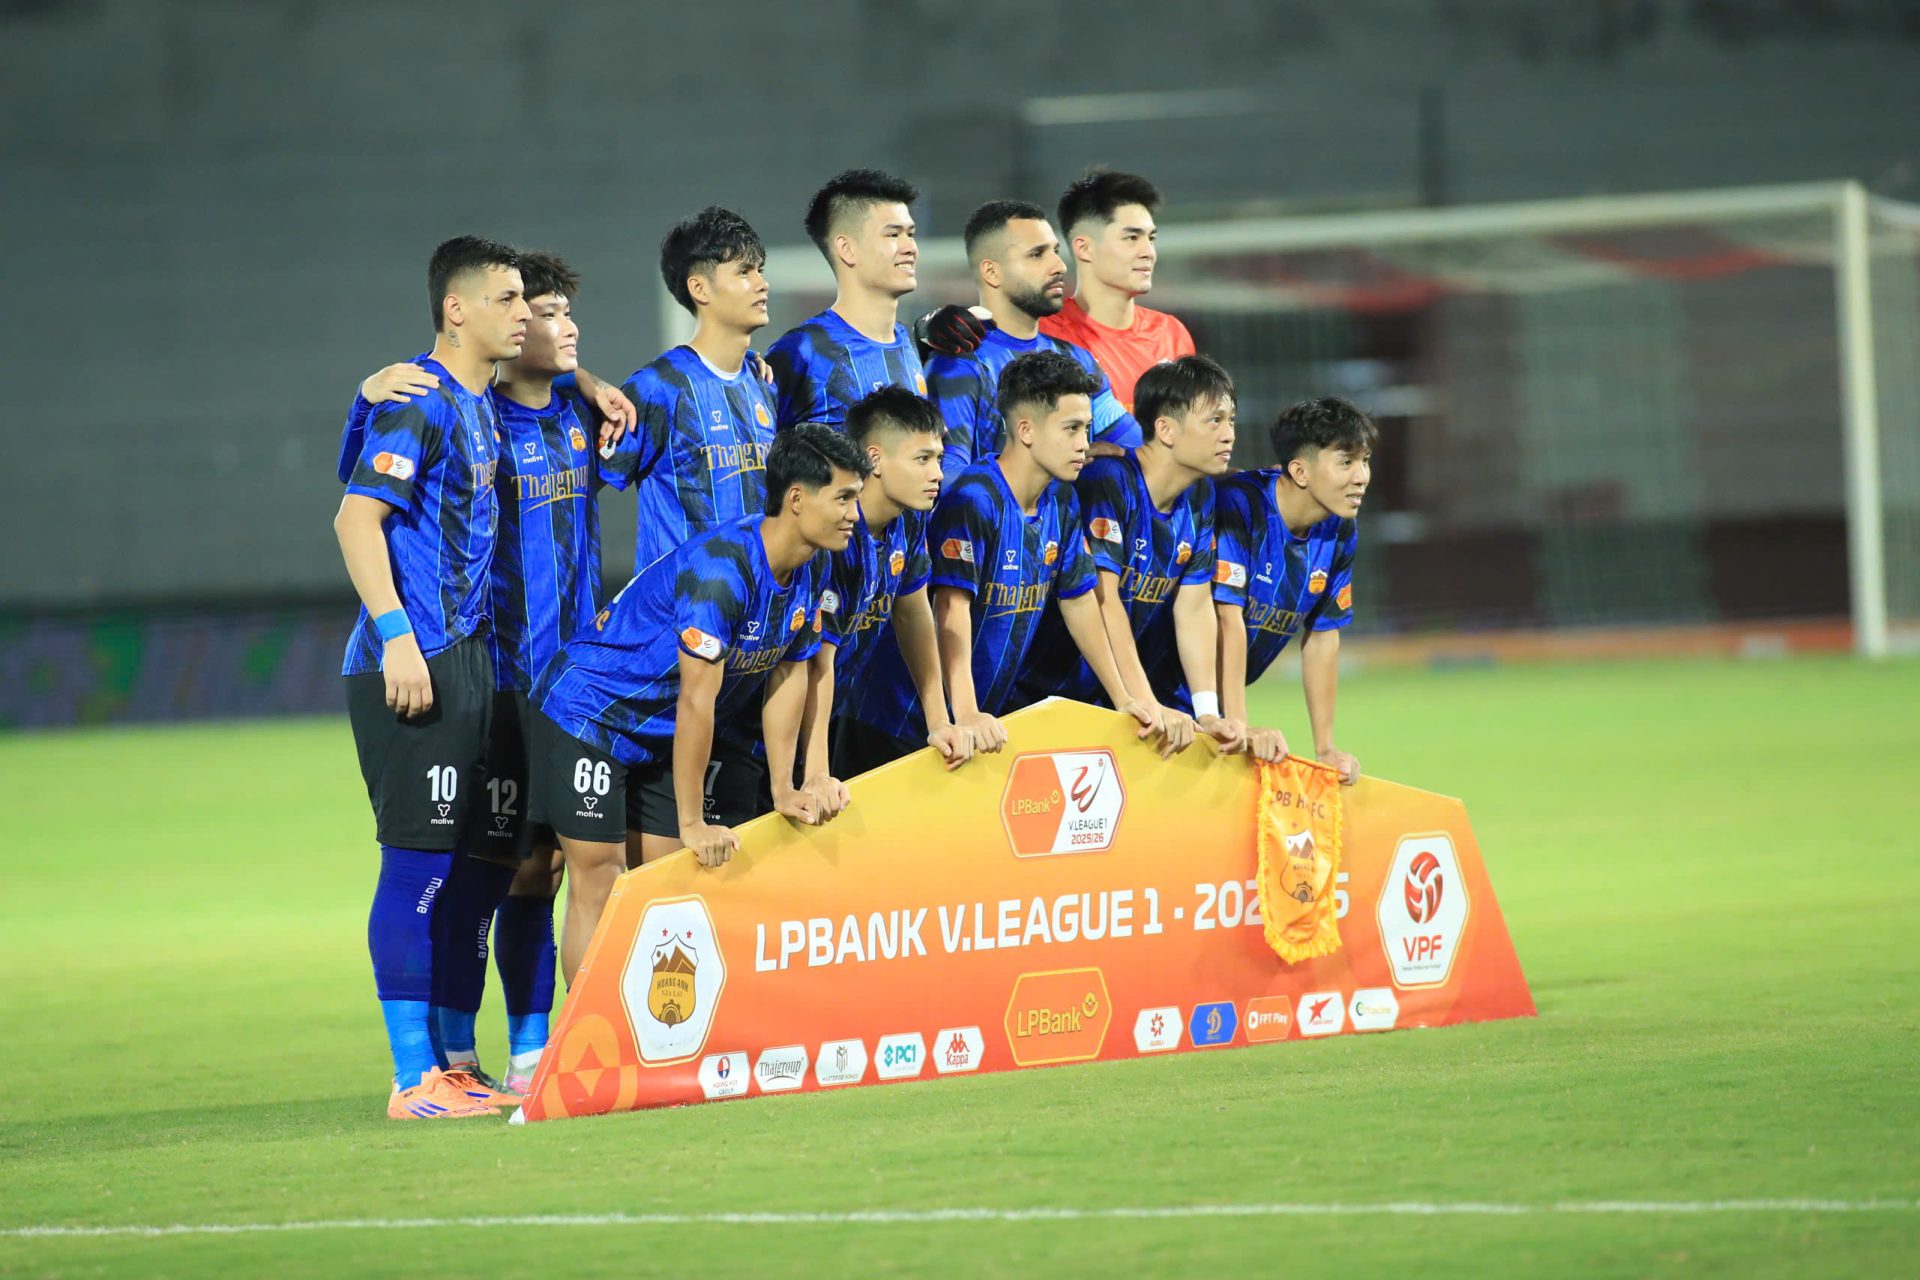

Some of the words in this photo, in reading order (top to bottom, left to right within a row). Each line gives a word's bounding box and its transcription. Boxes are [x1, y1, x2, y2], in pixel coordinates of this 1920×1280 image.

[426, 765, 458, 802] 10
[573, 757, 611, 796] 66
[486, 777, 518, 816] 12
[1011, 797, 1050, 816] LPBank
[576, 810, 603, 819] motive
[1068, 818, 1104, 831] V.LEAGUE
[487, 829, 513, 838] motive
[1071, 832, 1104, 845] 2025/26
[416, 877, 443, 914] motive
[477, 917, 490, 959] motive
[755, 907, 928, 972] LPBANK
[938, 889, 1133, 954] V.LEAGUE
[1143, 887, 1163, 936] 1
[1403, 934, 1442, 962] VPF
[1017, 1006, 1081, 1037] LPBank
[1259, 1014, 1273, 1025] FPT
[1273, 1013, 1288, 1025] Play
[895, 1044, 916, 1064] PC1
[946, 1052, 969, 1067] Kappa
[759, 1059, 801, 1078] Thaigroup
